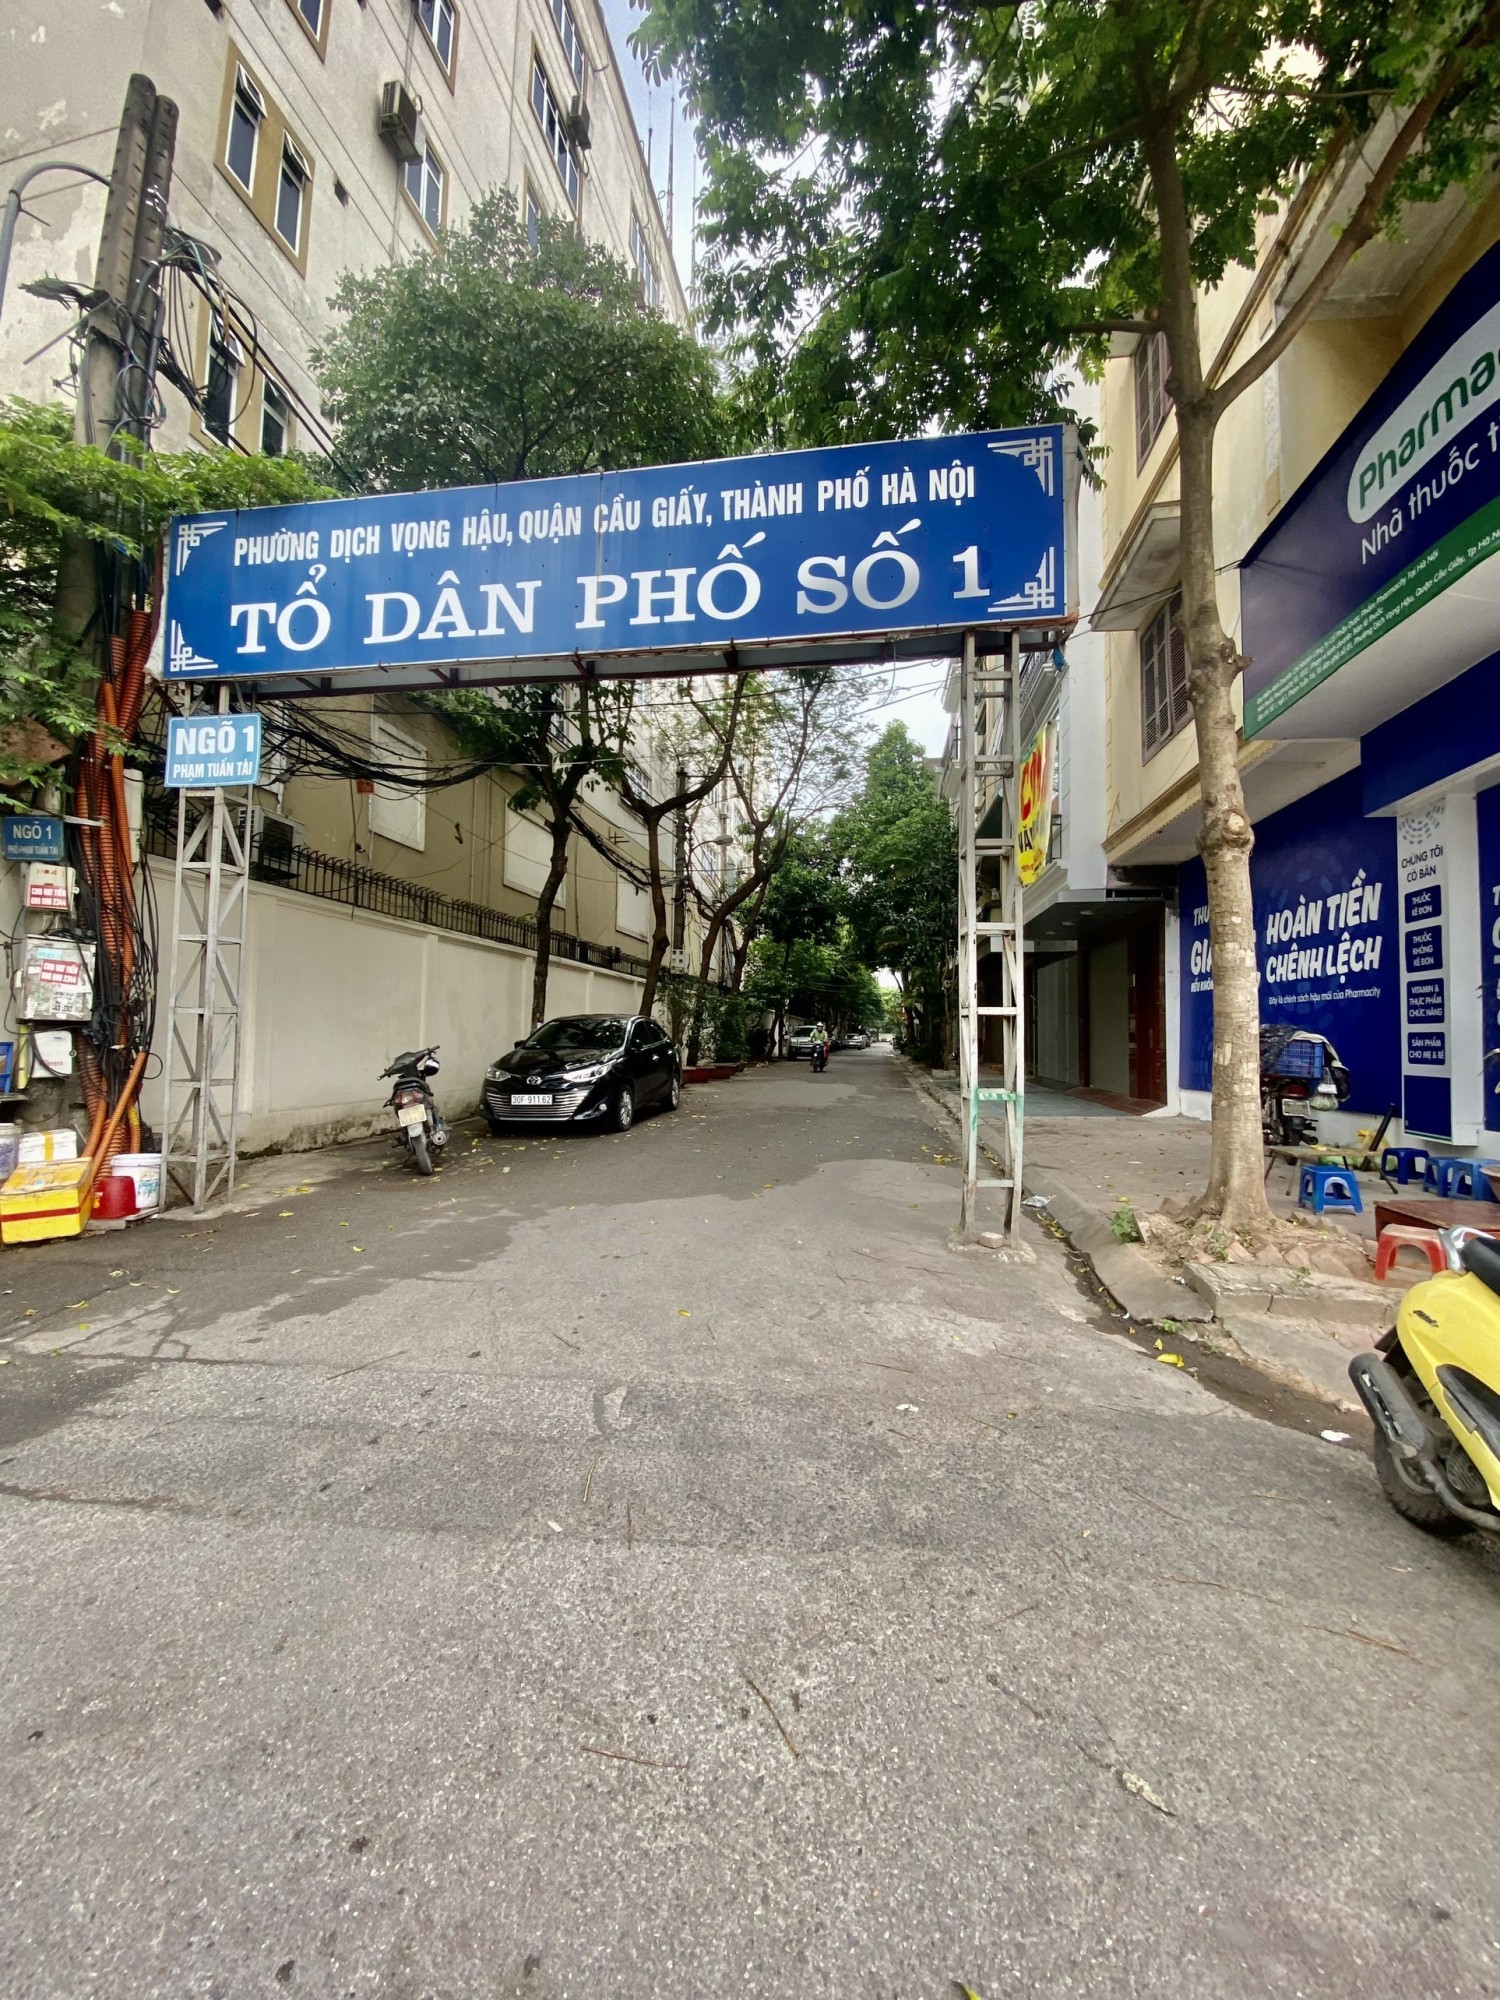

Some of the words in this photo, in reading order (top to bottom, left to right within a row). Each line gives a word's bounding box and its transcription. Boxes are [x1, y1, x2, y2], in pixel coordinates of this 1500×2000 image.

[1359, 348, 1500, 510] Pharma
[1361, 508, 1402, 565] Nhà
[1408, 443, 1480, 520] thuốc
[1487, 415, 1500, 452] t
[234, 527, 319, 566] PHƯỜNG
[330, 525, 380, 563] DỊCH
[391, 519, 450, 557] VỌNG
[462, 508, 513, 551] HẬU,
[518, 502, 582, 543] QUẬN
[594, 493, 641, 533] CẦU
[652, 485, 712, 527] GIẤY,
[721, 480, 802, 521] THÀNH
[817, 466, 870, 511] PHỐ
[882, 466, 917, 506] HÀ
[928, 459, 974, 506] NỘI
[230, 563, 331, 654] TỔ
[363, 570, 542, 645] DÂN
[575, 531, 766, 629] PHỐ
[797, 518, 921, 615] SỐ
[952, 545, 990, 599] 1
[175, 720, 236, 755] NGÕ
[242, 725, 255, 753] 1
[173, 763, 205, 781] PHẠM
[207, 757, 234, 778] TUẤN
[237, 758, 253, 776] TÀI
[13, 820, 42, 839] NGÕ
[46, 824, 52, 840] 1
[1401, 851, 1428, 868] CHÚNG
[1430, 845, 1443, 859] TÔI
[1407, 869, 1417, 882] CÓ
[1419, 865, 1436, 879] BÁN
[1266, 894, 1323, 945] HOÀN
[1327, 868, 1382, 931] TIỀN
[1412, 891, 1432, 905] THUỐC
[1193, 905, 1210, 926] THU
[1412, 931, 1432, 943] THUỐC
[1266, 943, 1324, 984] CHÊNH
[1325, 931, 1383, 984] LỆCH
[1412, 945, 1433, 955] KHÔNG
[1297, 993, 1310, 1003] sách
[1310, 992, 1320, 1003] hậu
[1344, 986, 1381, 998] Pharmacity
[1411, 985, 1433, 993] VITAMIN
[1434, 984, 1439, 992] &
[1409, 997, 1425, 1006] THỰC
[1425, 993, 1442, 1004] PHẨM
[1409, 1008, 1425, 1017] CHỨC
[1426, 1006, 1442, 1016] NĂNG
[1411, 1037, 1423, 1047] SẢN
[1425, 1035, 1442, 1047] PHẨM
[1409, 1050, 1422, 1058] CHO
